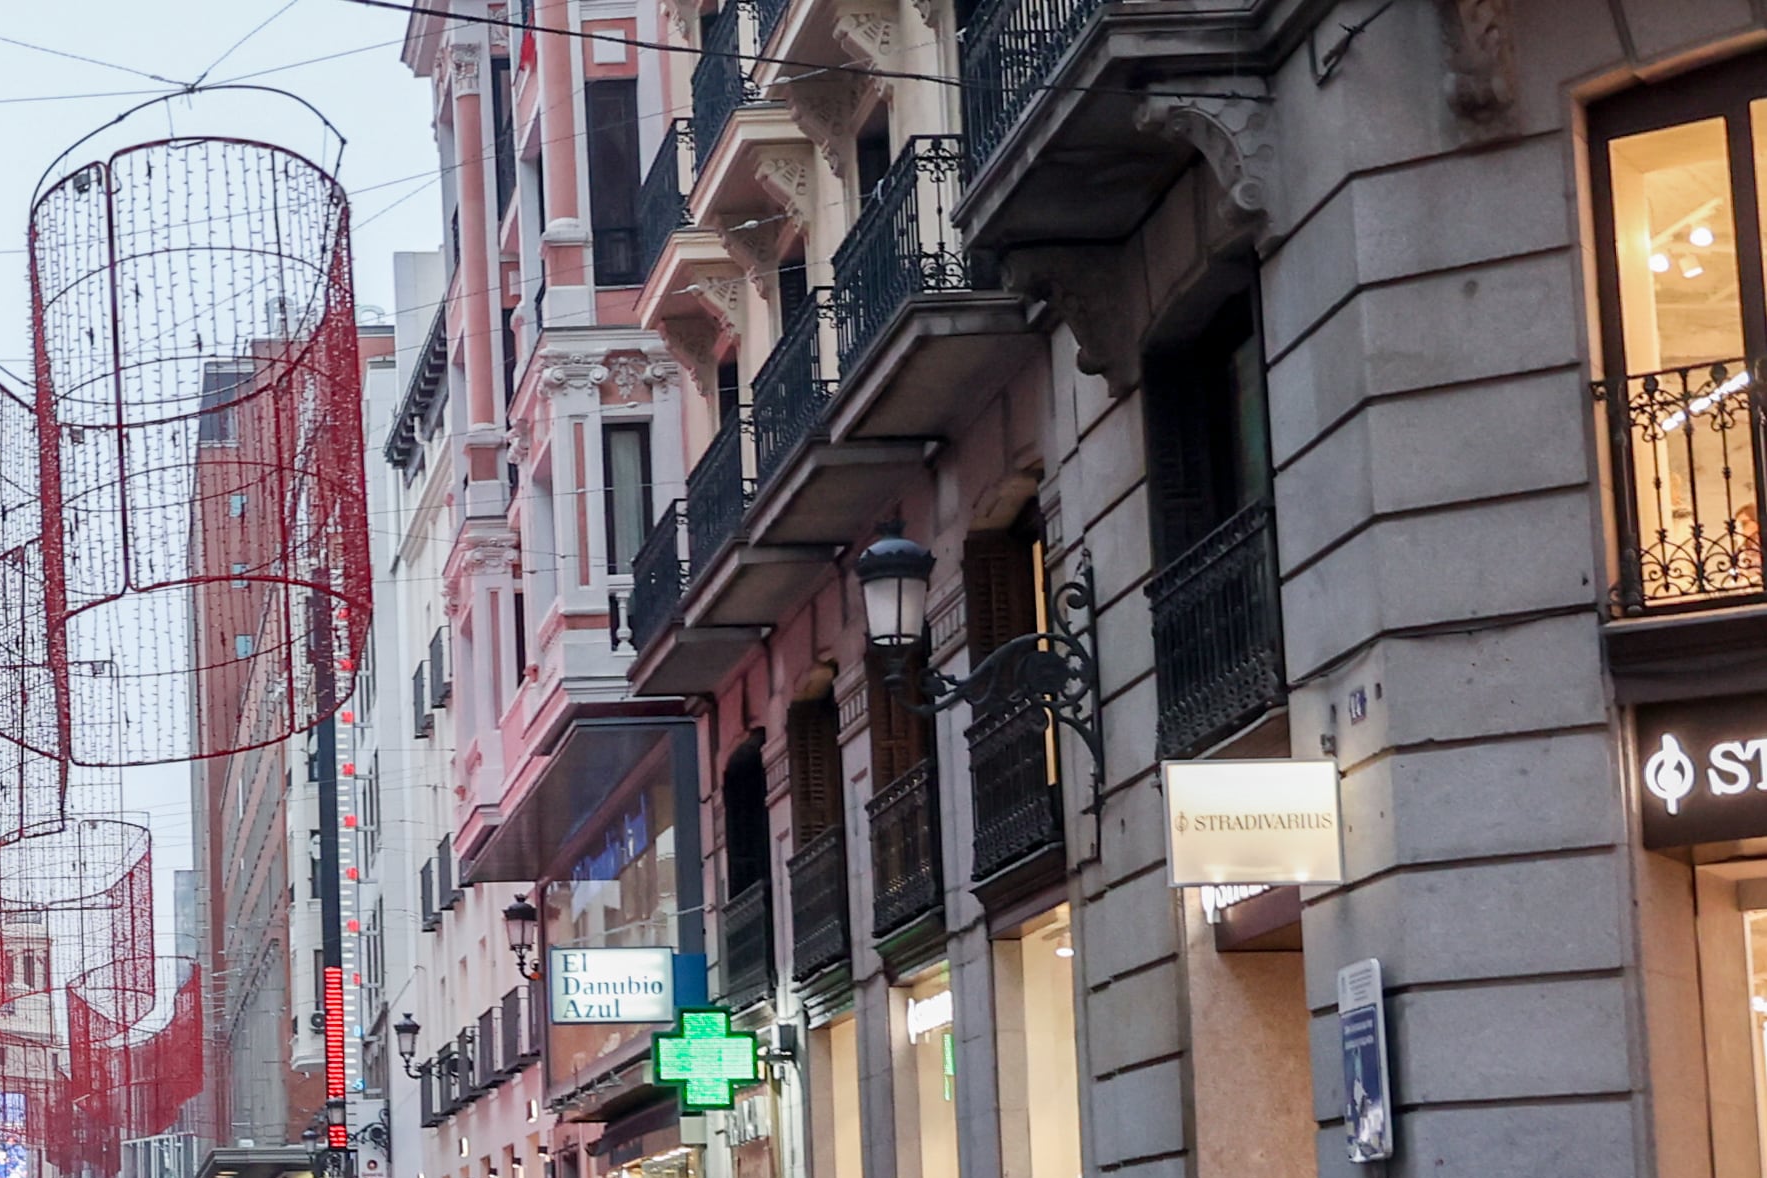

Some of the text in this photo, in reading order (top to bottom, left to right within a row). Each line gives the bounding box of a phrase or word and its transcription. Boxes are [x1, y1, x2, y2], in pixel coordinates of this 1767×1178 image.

[1193, 811, 1333, 833] STRADIVARIUS
[561, 952, 587, 973] El
[561, 975, 664, 996] Danubio
[562, 997, 622, 1019] Azul
